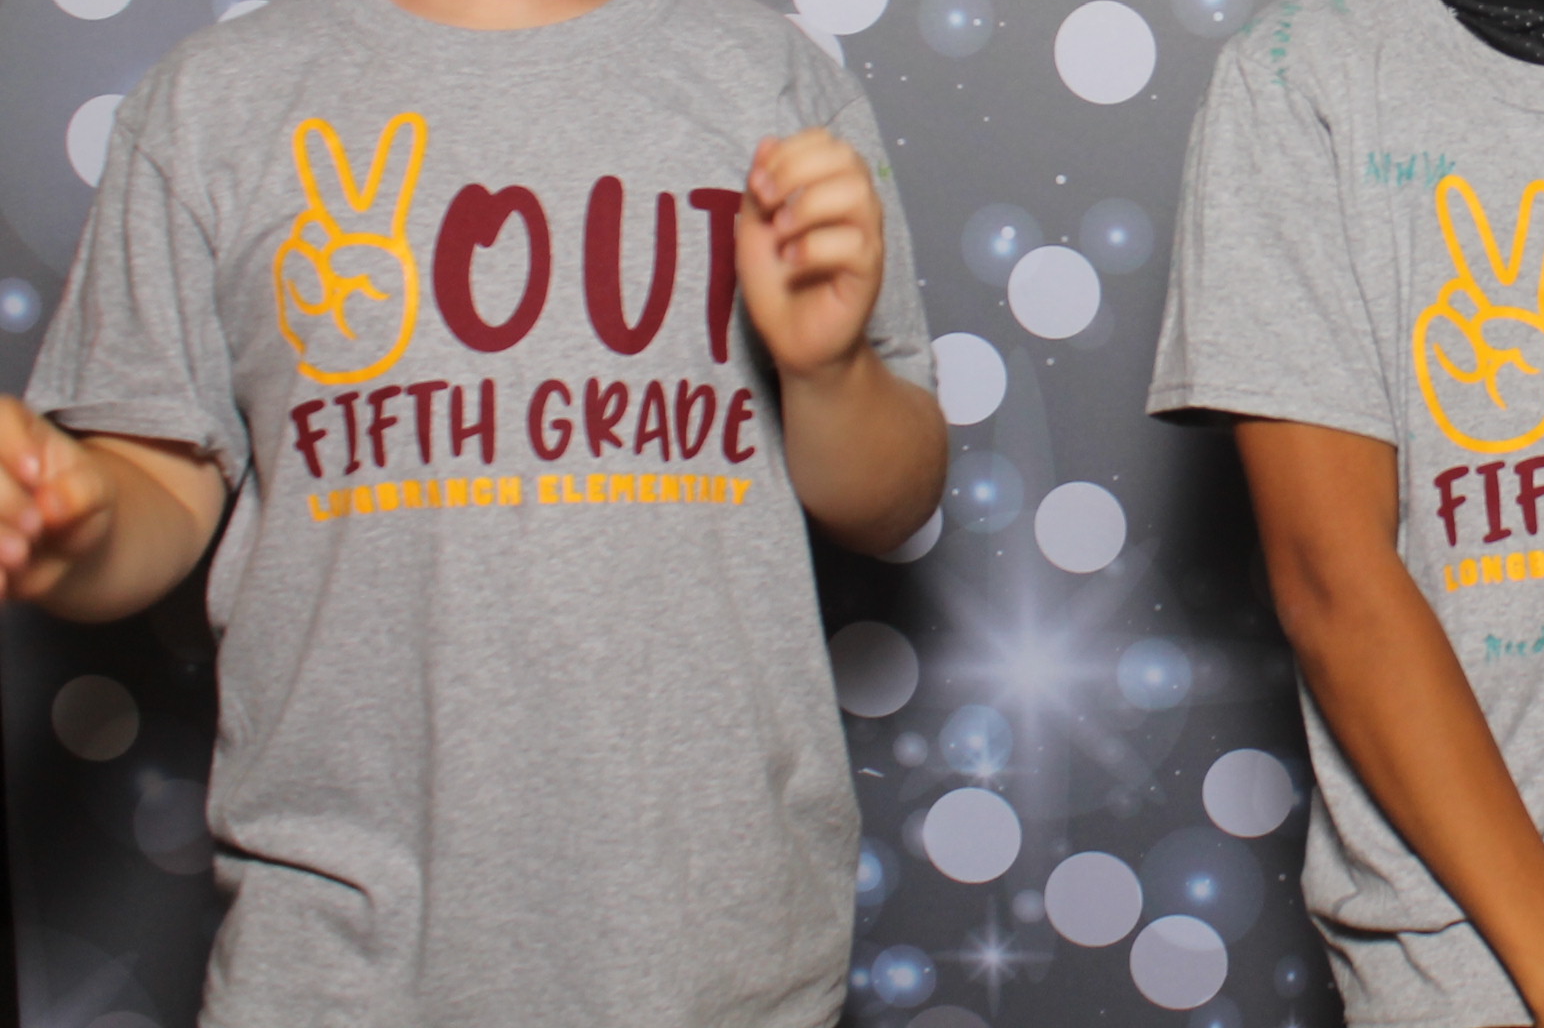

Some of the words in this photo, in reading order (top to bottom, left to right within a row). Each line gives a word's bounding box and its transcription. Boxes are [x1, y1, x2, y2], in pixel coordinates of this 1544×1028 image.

[432, 175, 743, 363] OUT
[290, 377, 496, 478] FIFTH
[528, 377, 756, 464] GRADE
